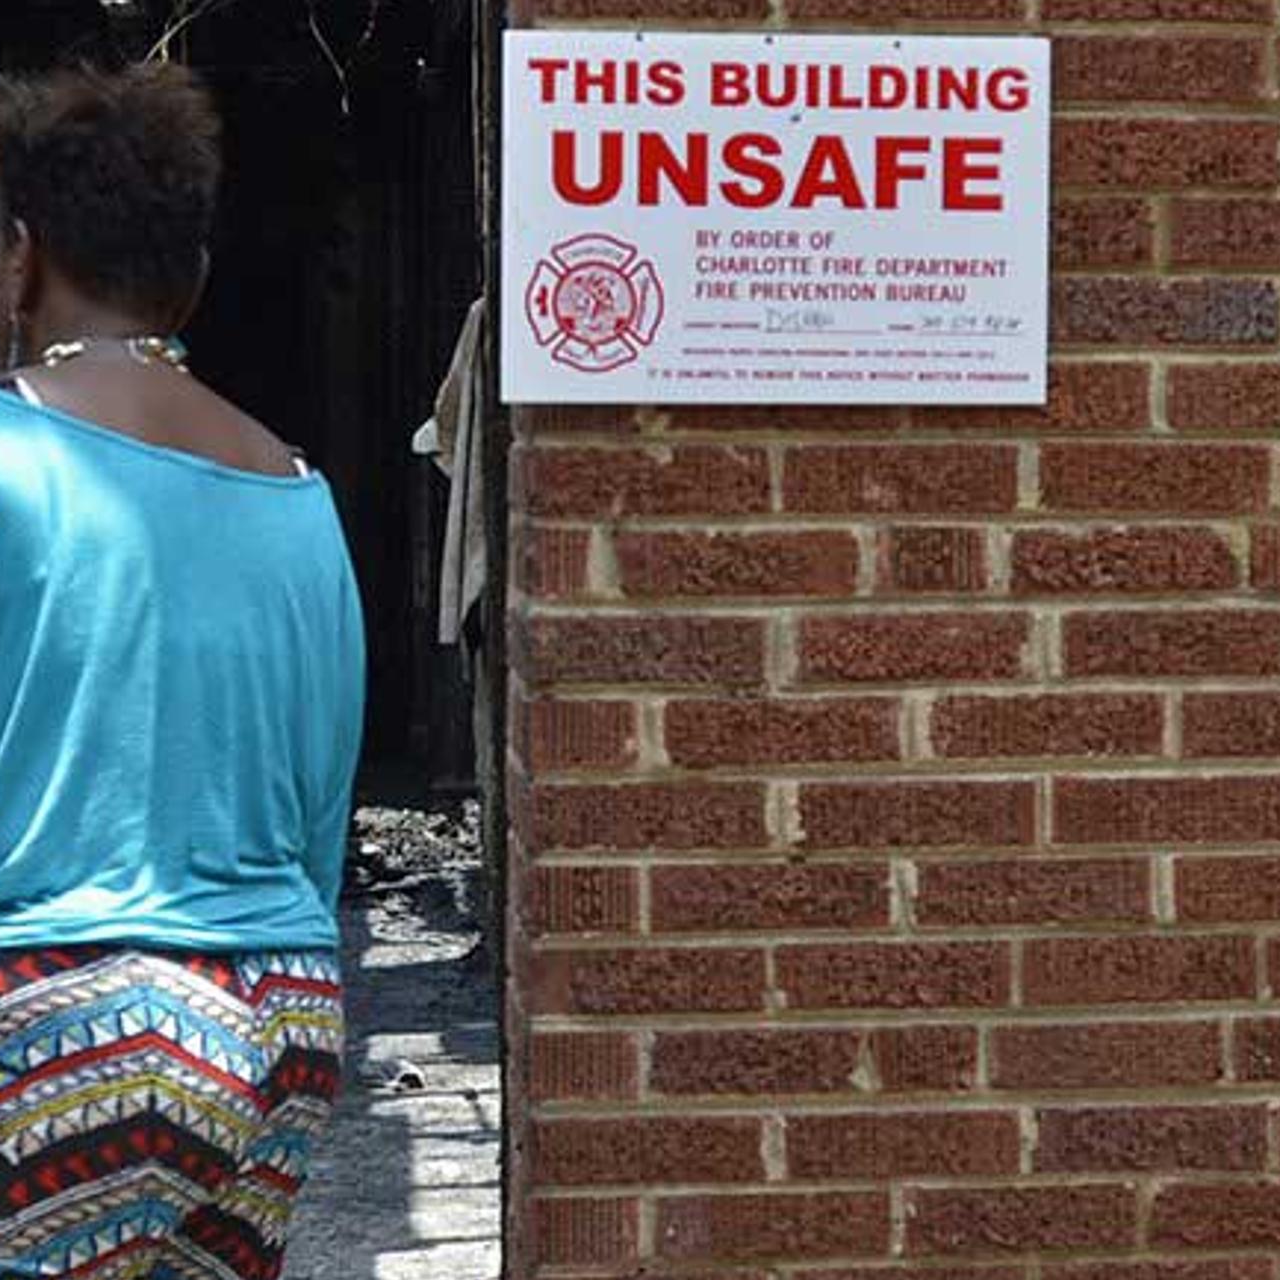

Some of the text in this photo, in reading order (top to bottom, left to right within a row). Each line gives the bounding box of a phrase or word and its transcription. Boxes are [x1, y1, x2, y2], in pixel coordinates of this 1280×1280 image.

[528, 58, 1030, 112] THIS BUILDING
[551, 129, 1004, 212] UNSAFE
[695, 229, 835, 251] BY ORDER OF
[695, 255, 1007, 279] CHARLOTTE FIRE DEPARTMENT
[695, 280, 967, 303] FIRE PREVENTION BUREAU
